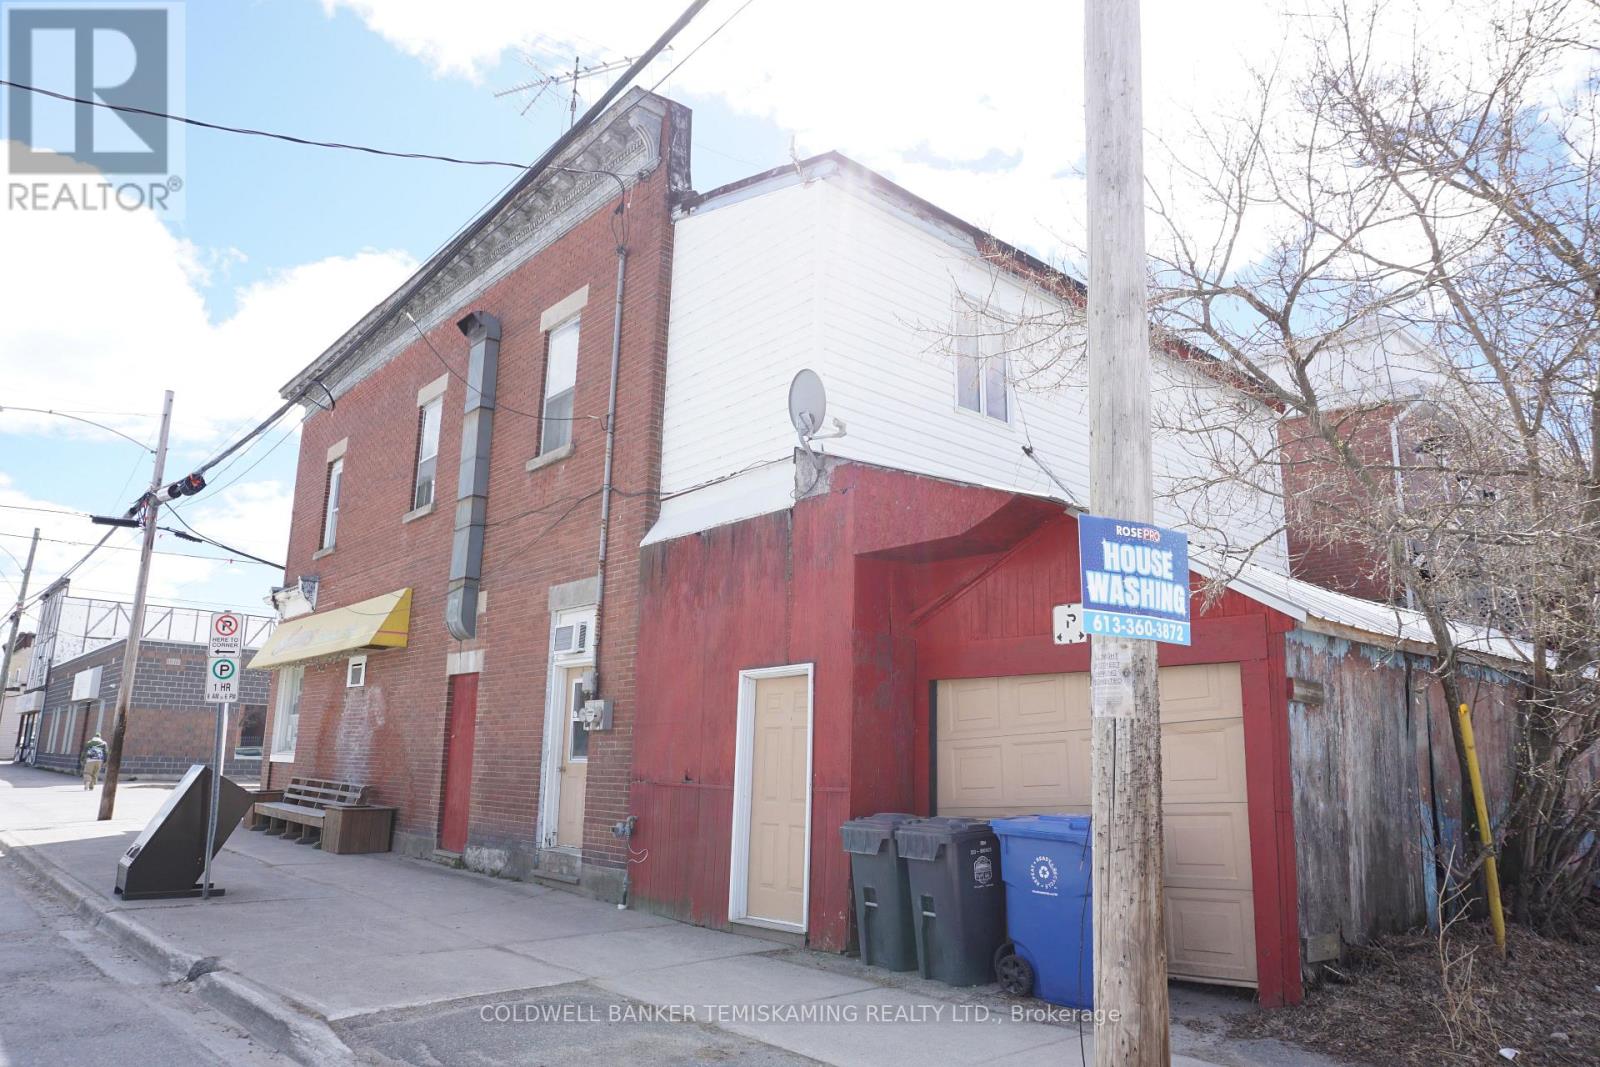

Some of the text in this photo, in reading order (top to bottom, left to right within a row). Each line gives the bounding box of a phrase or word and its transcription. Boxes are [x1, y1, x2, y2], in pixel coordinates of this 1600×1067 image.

[1103, 540, 1174, 580] HOUSE
[1086, 571, 1186, 616] WASHING
[1093, 616, 1184, 642] 613-360-3872
[219, 664, 230, 676] P
[220, 683, 231, 691] HR
